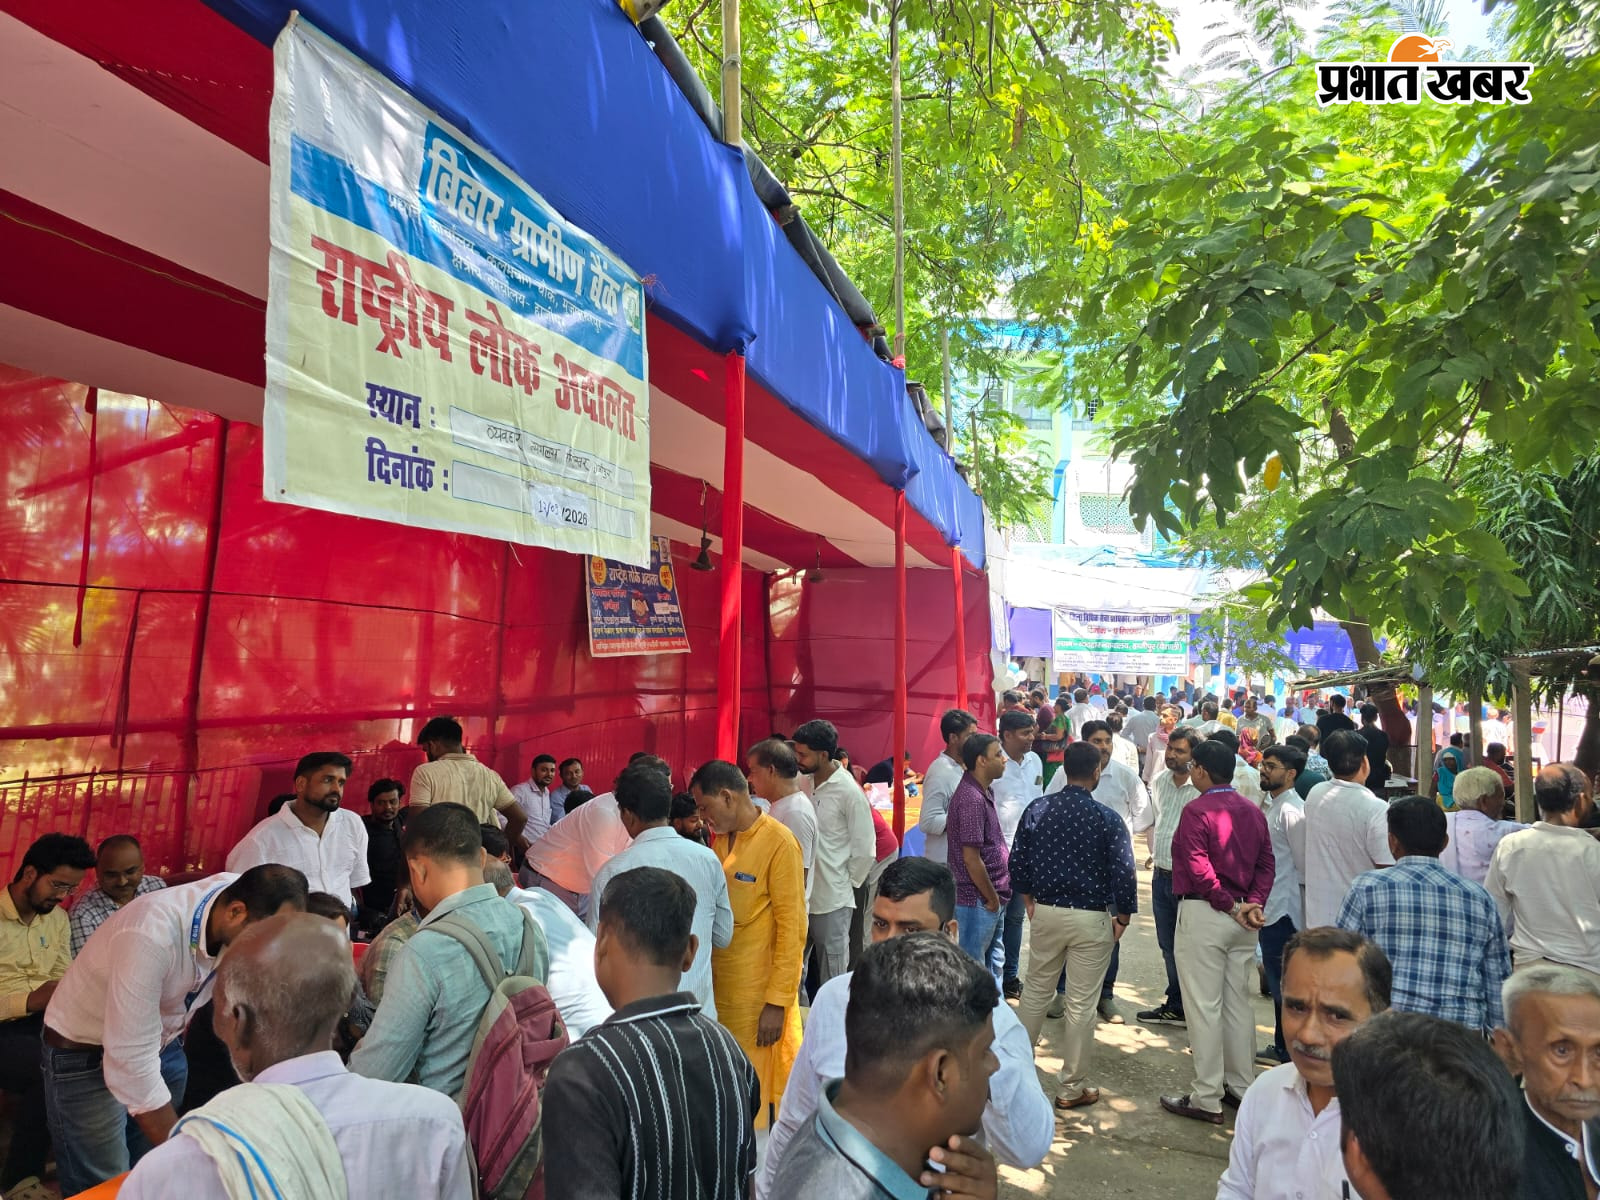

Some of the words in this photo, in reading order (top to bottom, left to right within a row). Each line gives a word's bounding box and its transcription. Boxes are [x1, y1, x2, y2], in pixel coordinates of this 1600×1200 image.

[427, 137, 503, 242] बिहार
[510, 206, 585, 297] ग्रामीण
[590, 251, 620, 318] बैंक
[311, 235, 454, 363] राष्ट्रीय
[465, 299, 542, 396] लोक
[553, 353, 636, 441] अदालत
[365, 382, 421, 429] स्थान
[365, 437, 435, 491] दिनांक
